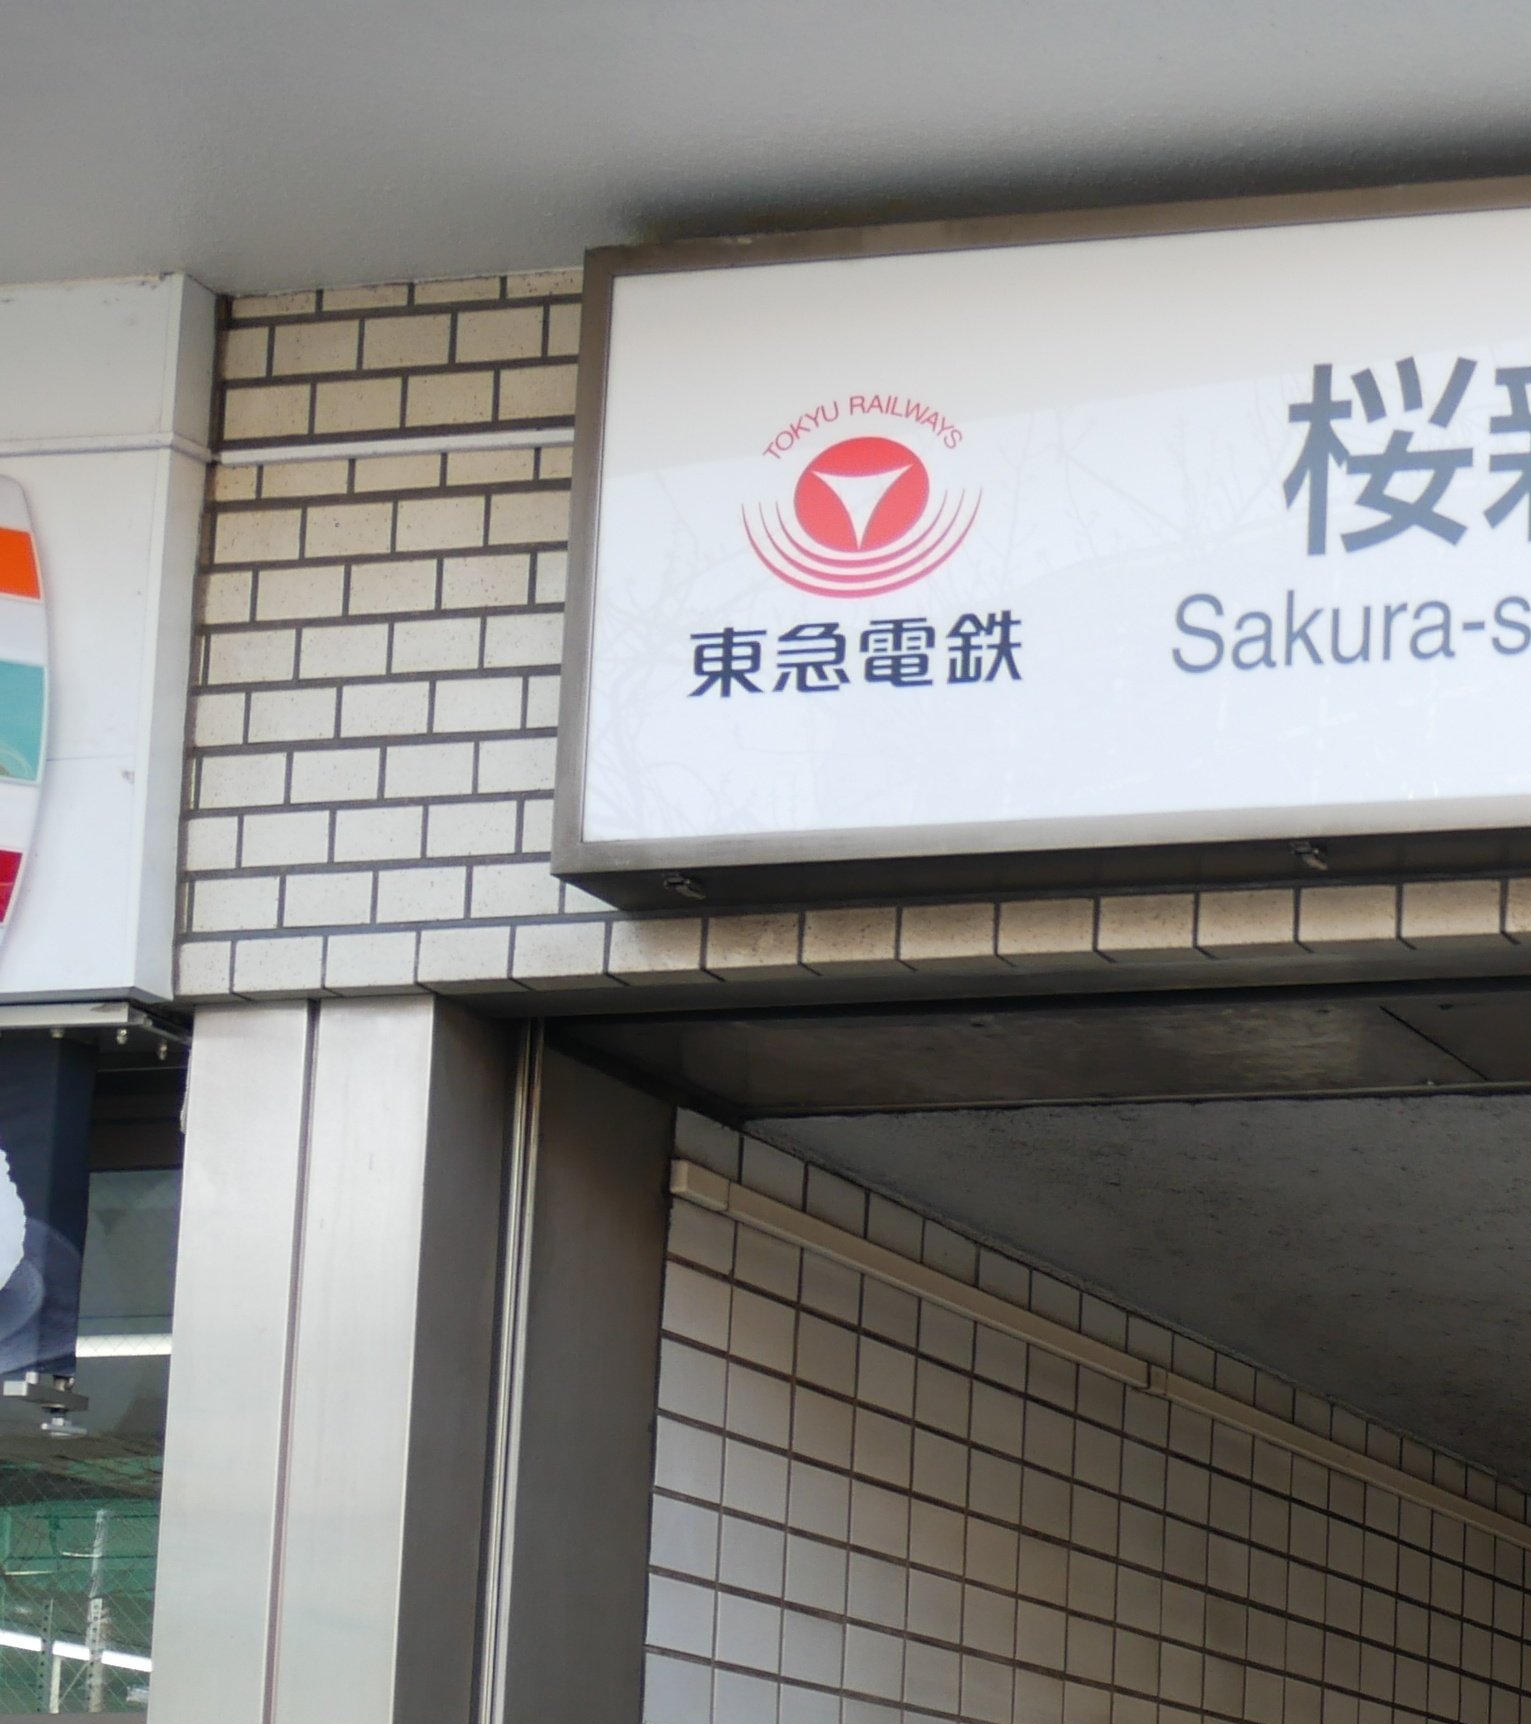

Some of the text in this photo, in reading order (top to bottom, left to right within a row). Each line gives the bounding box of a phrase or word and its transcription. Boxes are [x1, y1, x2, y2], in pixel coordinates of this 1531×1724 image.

[763, 394, 963, 461] TOKYU RAILWAYS
[686, 608, 1023, 699] 東急電鉄
